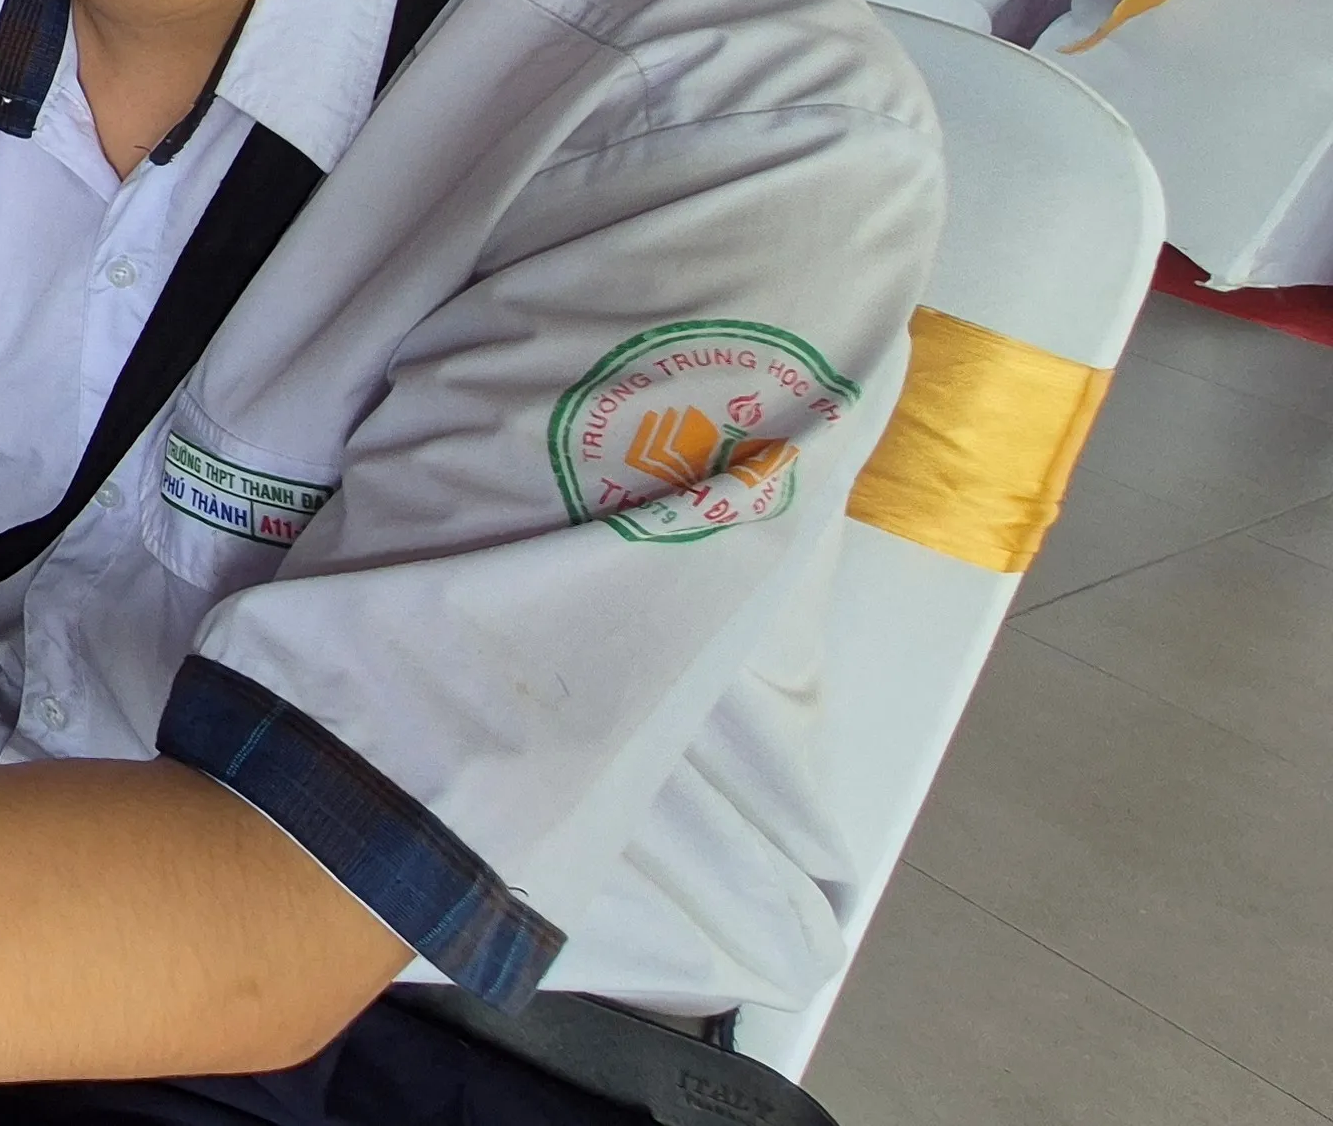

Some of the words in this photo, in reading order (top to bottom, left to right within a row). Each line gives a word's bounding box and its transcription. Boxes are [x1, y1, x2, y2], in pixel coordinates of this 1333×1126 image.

[583, 373, 653, 463] TRƯỜNG
[653, 347, 758, 377] TRUNG
[768, 359, 810, 398] HỌC
[162, 471, 184, 500] PHÚ
[191, 486, 248, 529] THÀNH
[205, 461, 236, 489] THPT
[240, 476, 295, 506] THANH
